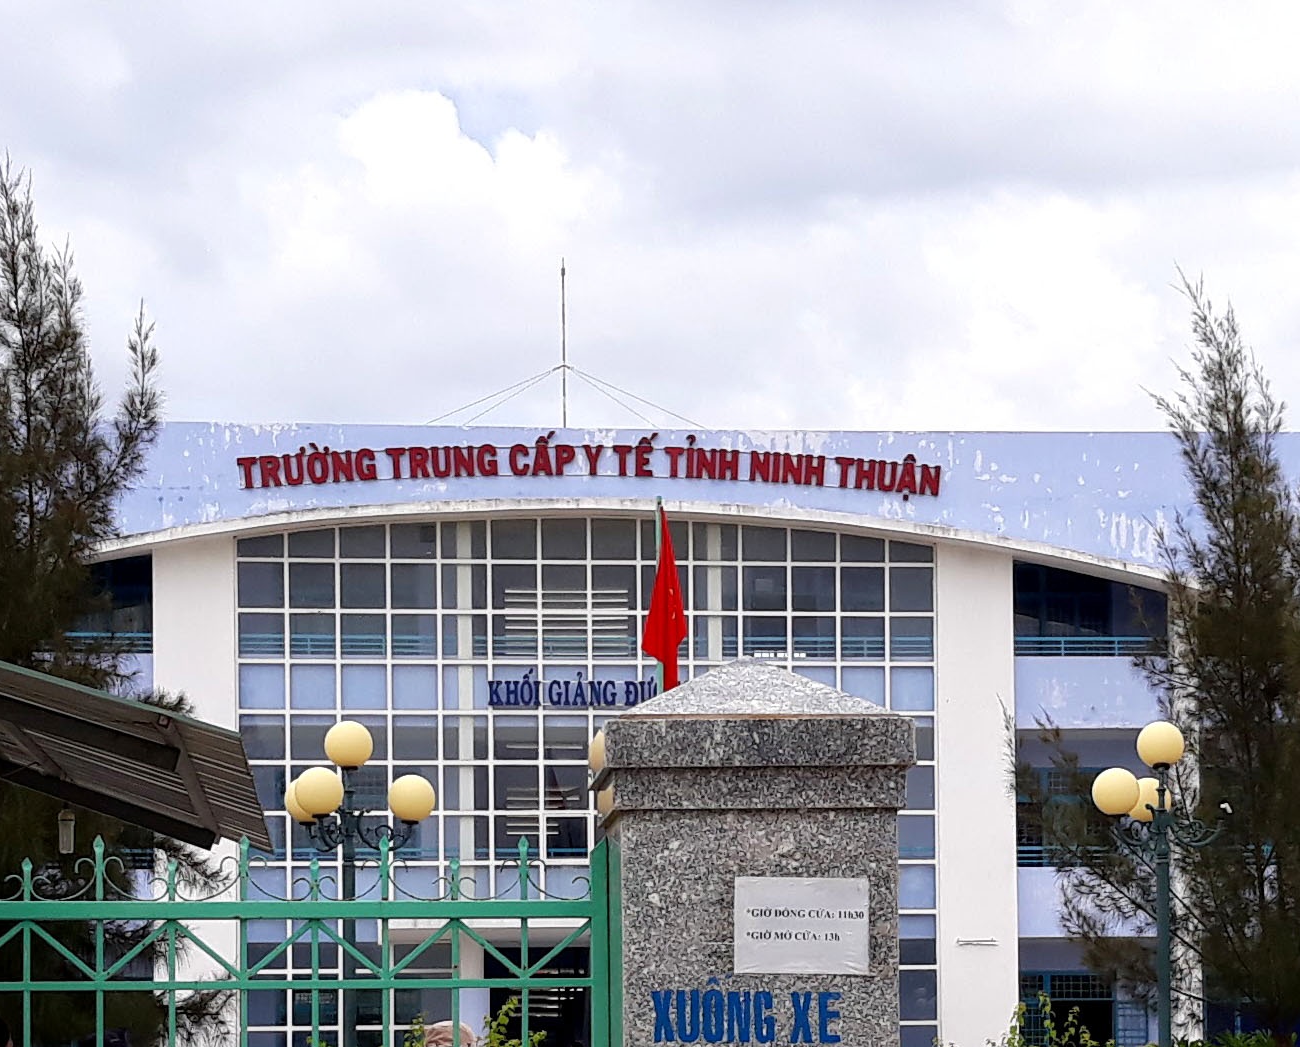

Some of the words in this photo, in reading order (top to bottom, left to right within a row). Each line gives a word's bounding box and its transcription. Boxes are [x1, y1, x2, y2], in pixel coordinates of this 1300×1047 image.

[236, 442, 378, 489] TRƯỜNG
[385, 445, 499, 480] TRUNG
[508, 430, 577, 477] CẤP
[582, 444, 604, 476] Y
[612, 432, 659, 477] TẾ
[664, 434, 740, 481] TỈNH
[750, 450, 826, 487] NINH
[835, 453, 942, 501] THUẬN
[487, 667, 542, 706] KHỐI
[549, 671, 617, 706] GIẢNG
[789, 991, 842, 1044] XE
